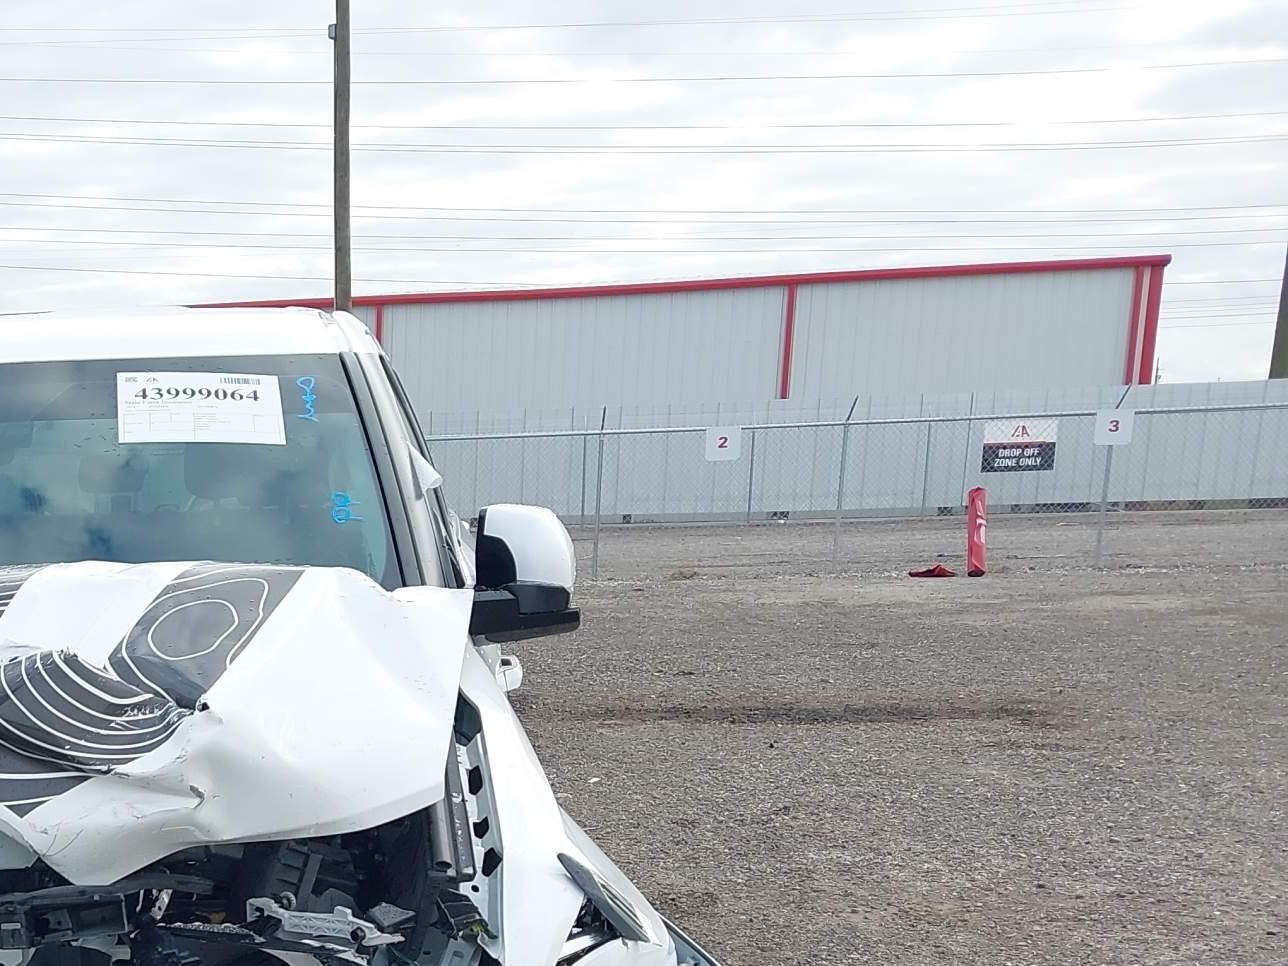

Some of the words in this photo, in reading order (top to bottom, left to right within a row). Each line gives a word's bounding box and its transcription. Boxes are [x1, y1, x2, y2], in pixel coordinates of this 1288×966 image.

[134, 387, 260, 402] 43999064
[1108, 419, 1120, 433] 3
[718, 436, 729, 449] 2
[998, 448, 1023, 458] DROP
[1023, 447, 1040, 457] OFF
[994, 457, 1019, 467] ZONE
[1018, 456, 1042, 466] ONLY
